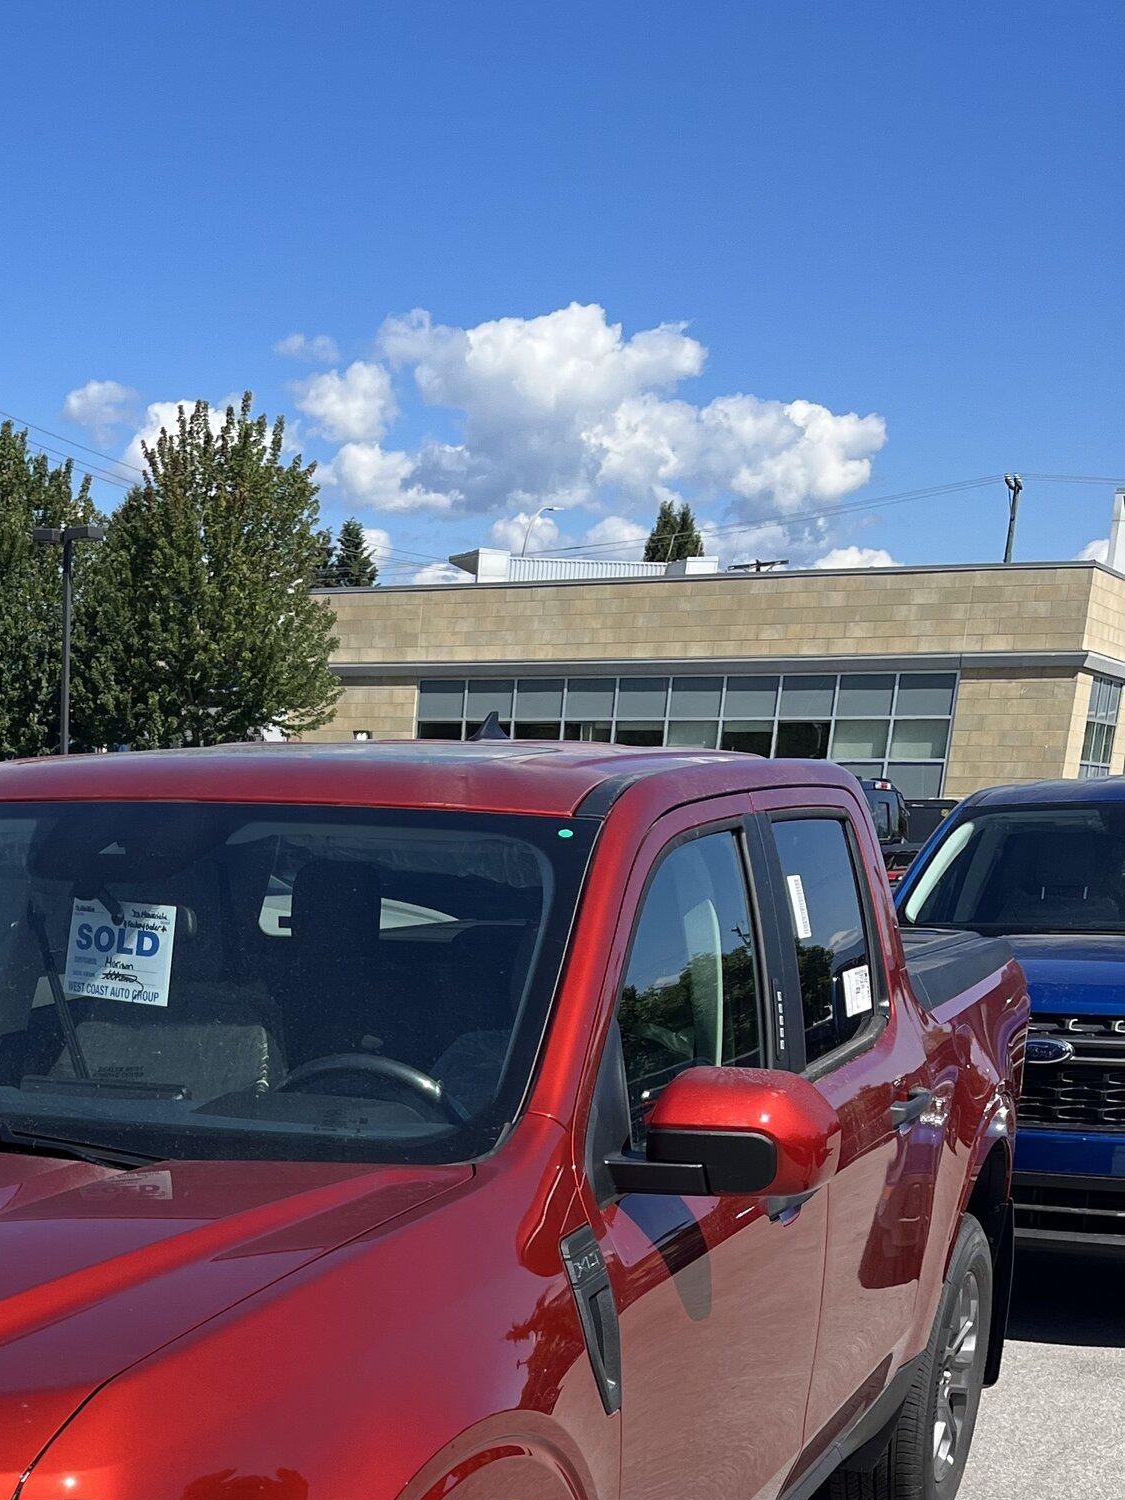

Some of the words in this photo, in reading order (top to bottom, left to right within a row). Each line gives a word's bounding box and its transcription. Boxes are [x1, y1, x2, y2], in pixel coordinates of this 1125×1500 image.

[76, 923, 160, 957] SOLD
[69, 981, 86, 993] WEST
[87, 983, 109, 996] COAST
[110, 986, 130, 999] AUTO
[132, 989, 159, 1002] GROUP
